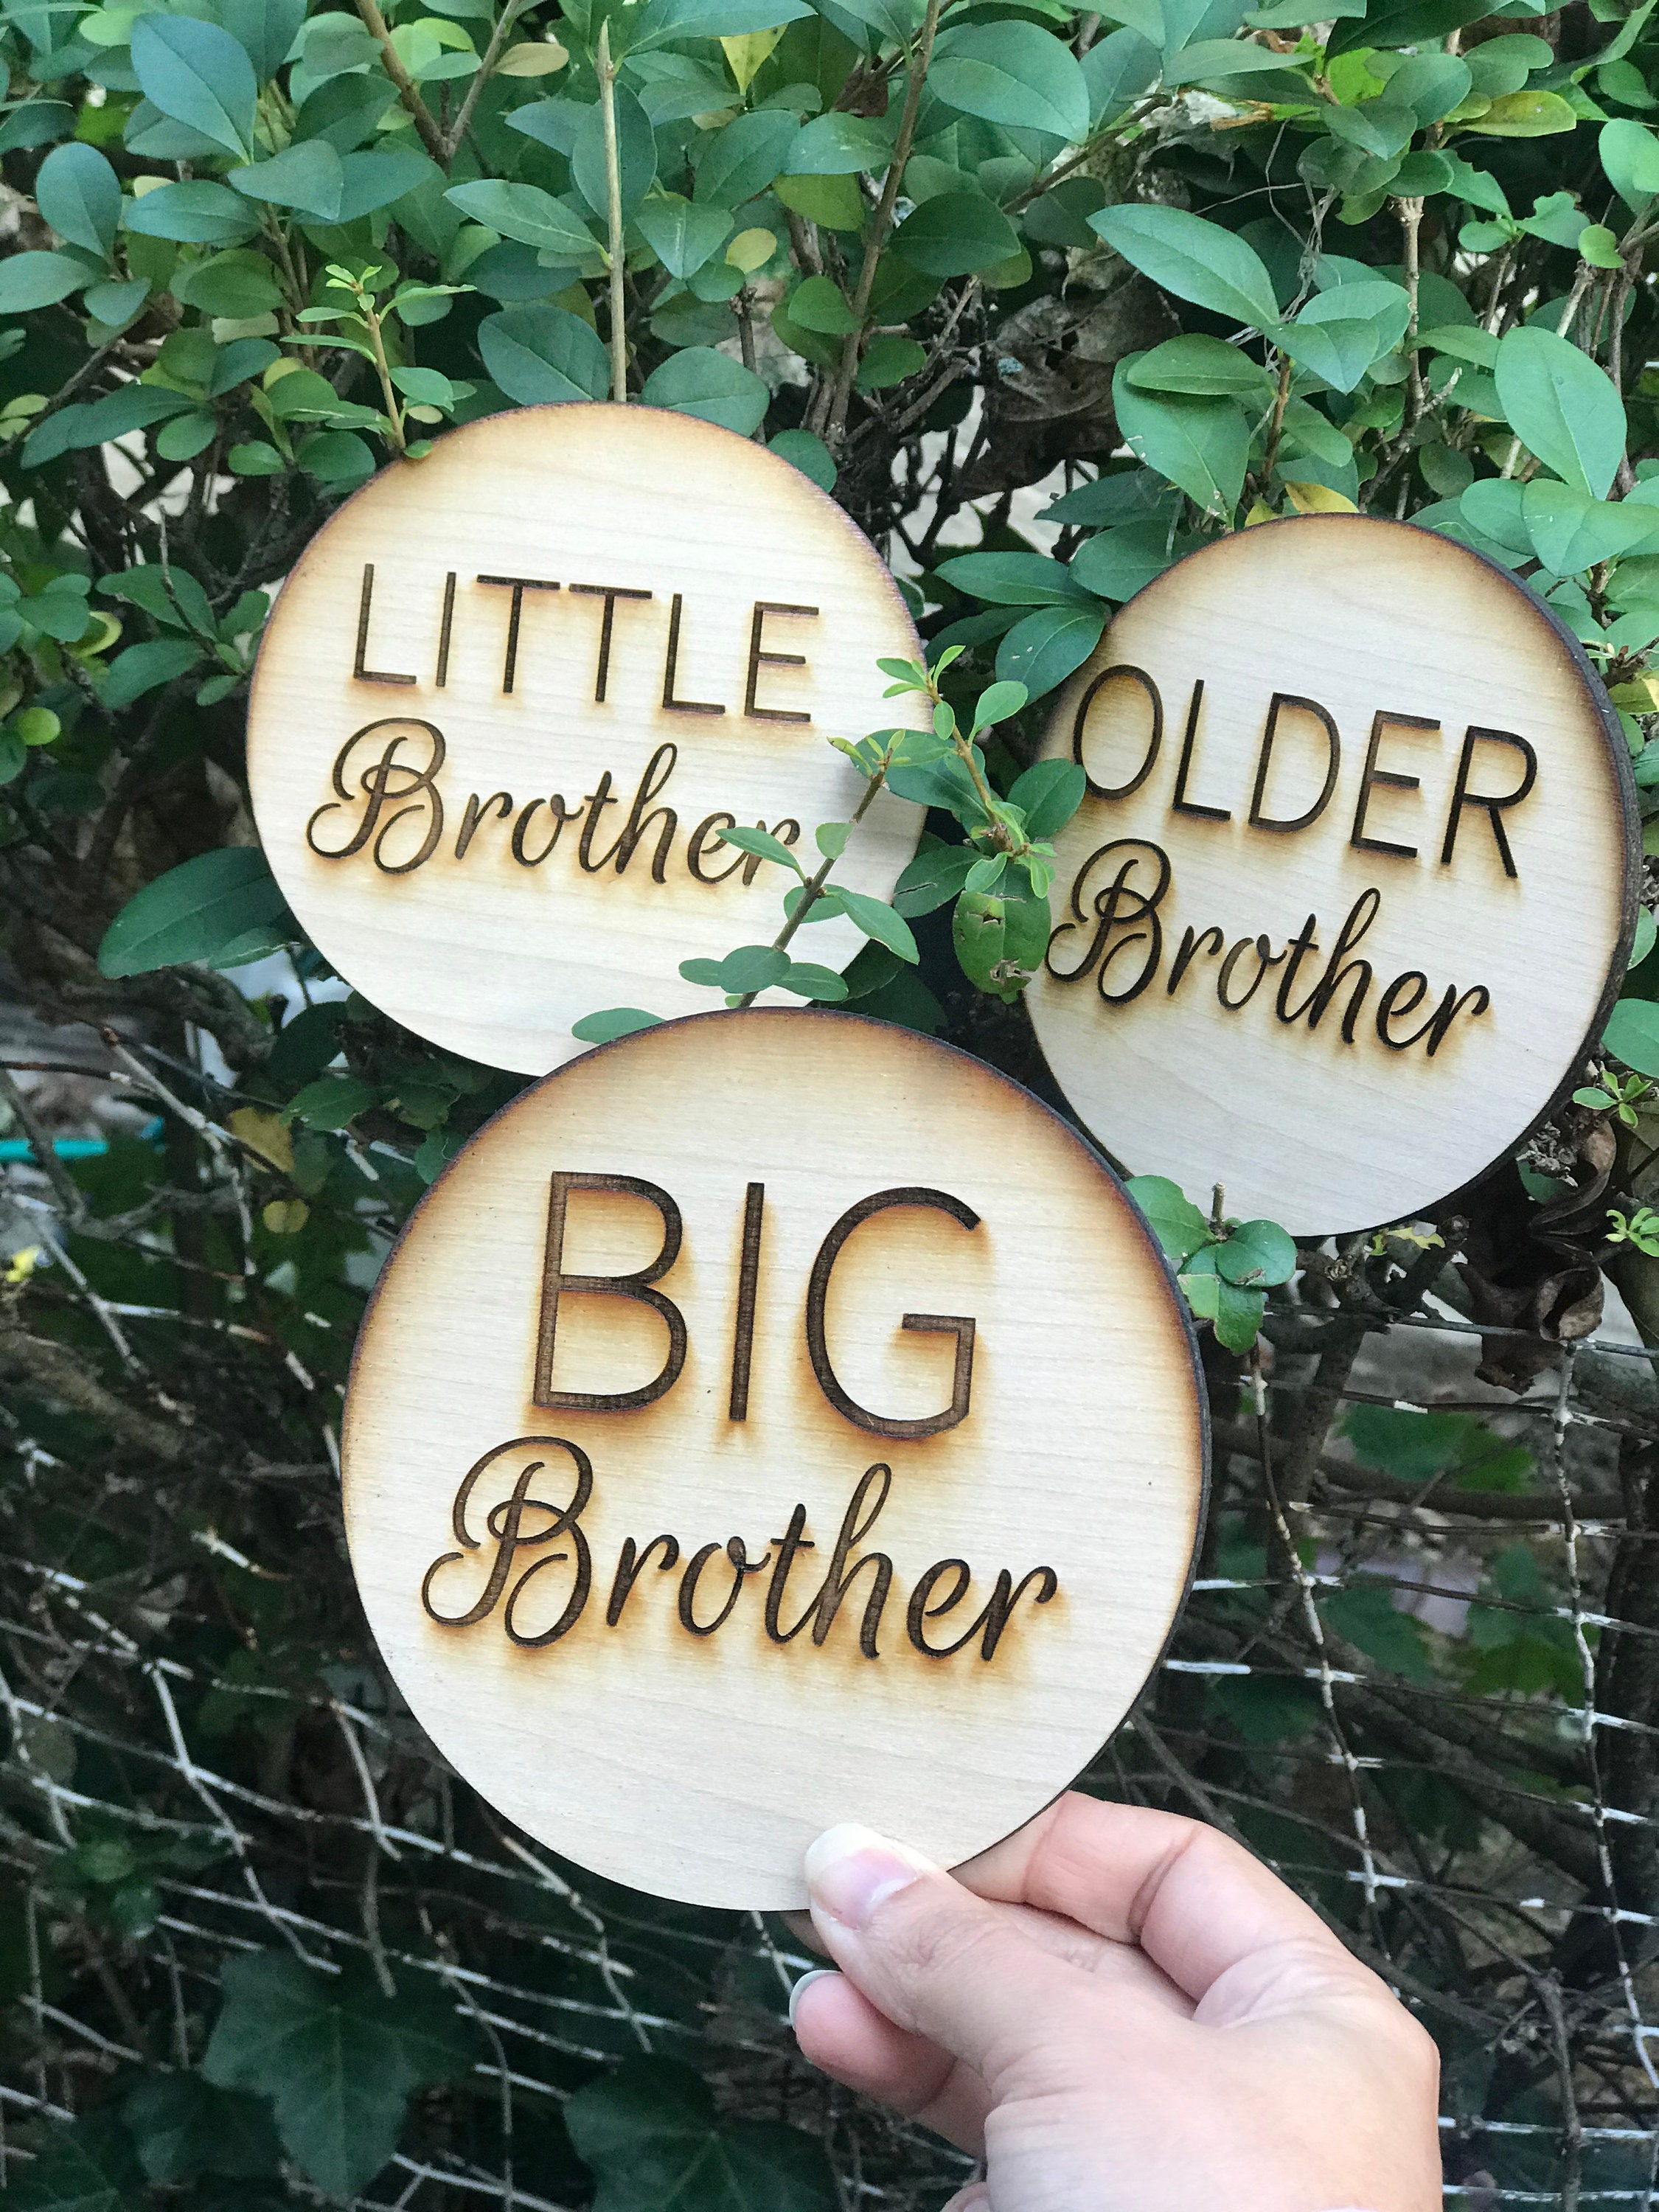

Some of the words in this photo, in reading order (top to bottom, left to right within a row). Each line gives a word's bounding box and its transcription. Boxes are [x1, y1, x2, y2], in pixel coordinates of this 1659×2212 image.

[353, 563, 820, 723] LITTLE
[306, 717, 801, 886] Brother
[1073, 664, 1538, 878] OLDER
[1046, 838, 1490, 1057] Brother
[533, 1171, 982, 1439] BIG
[422, 1435, 1058, 1661] Brother
